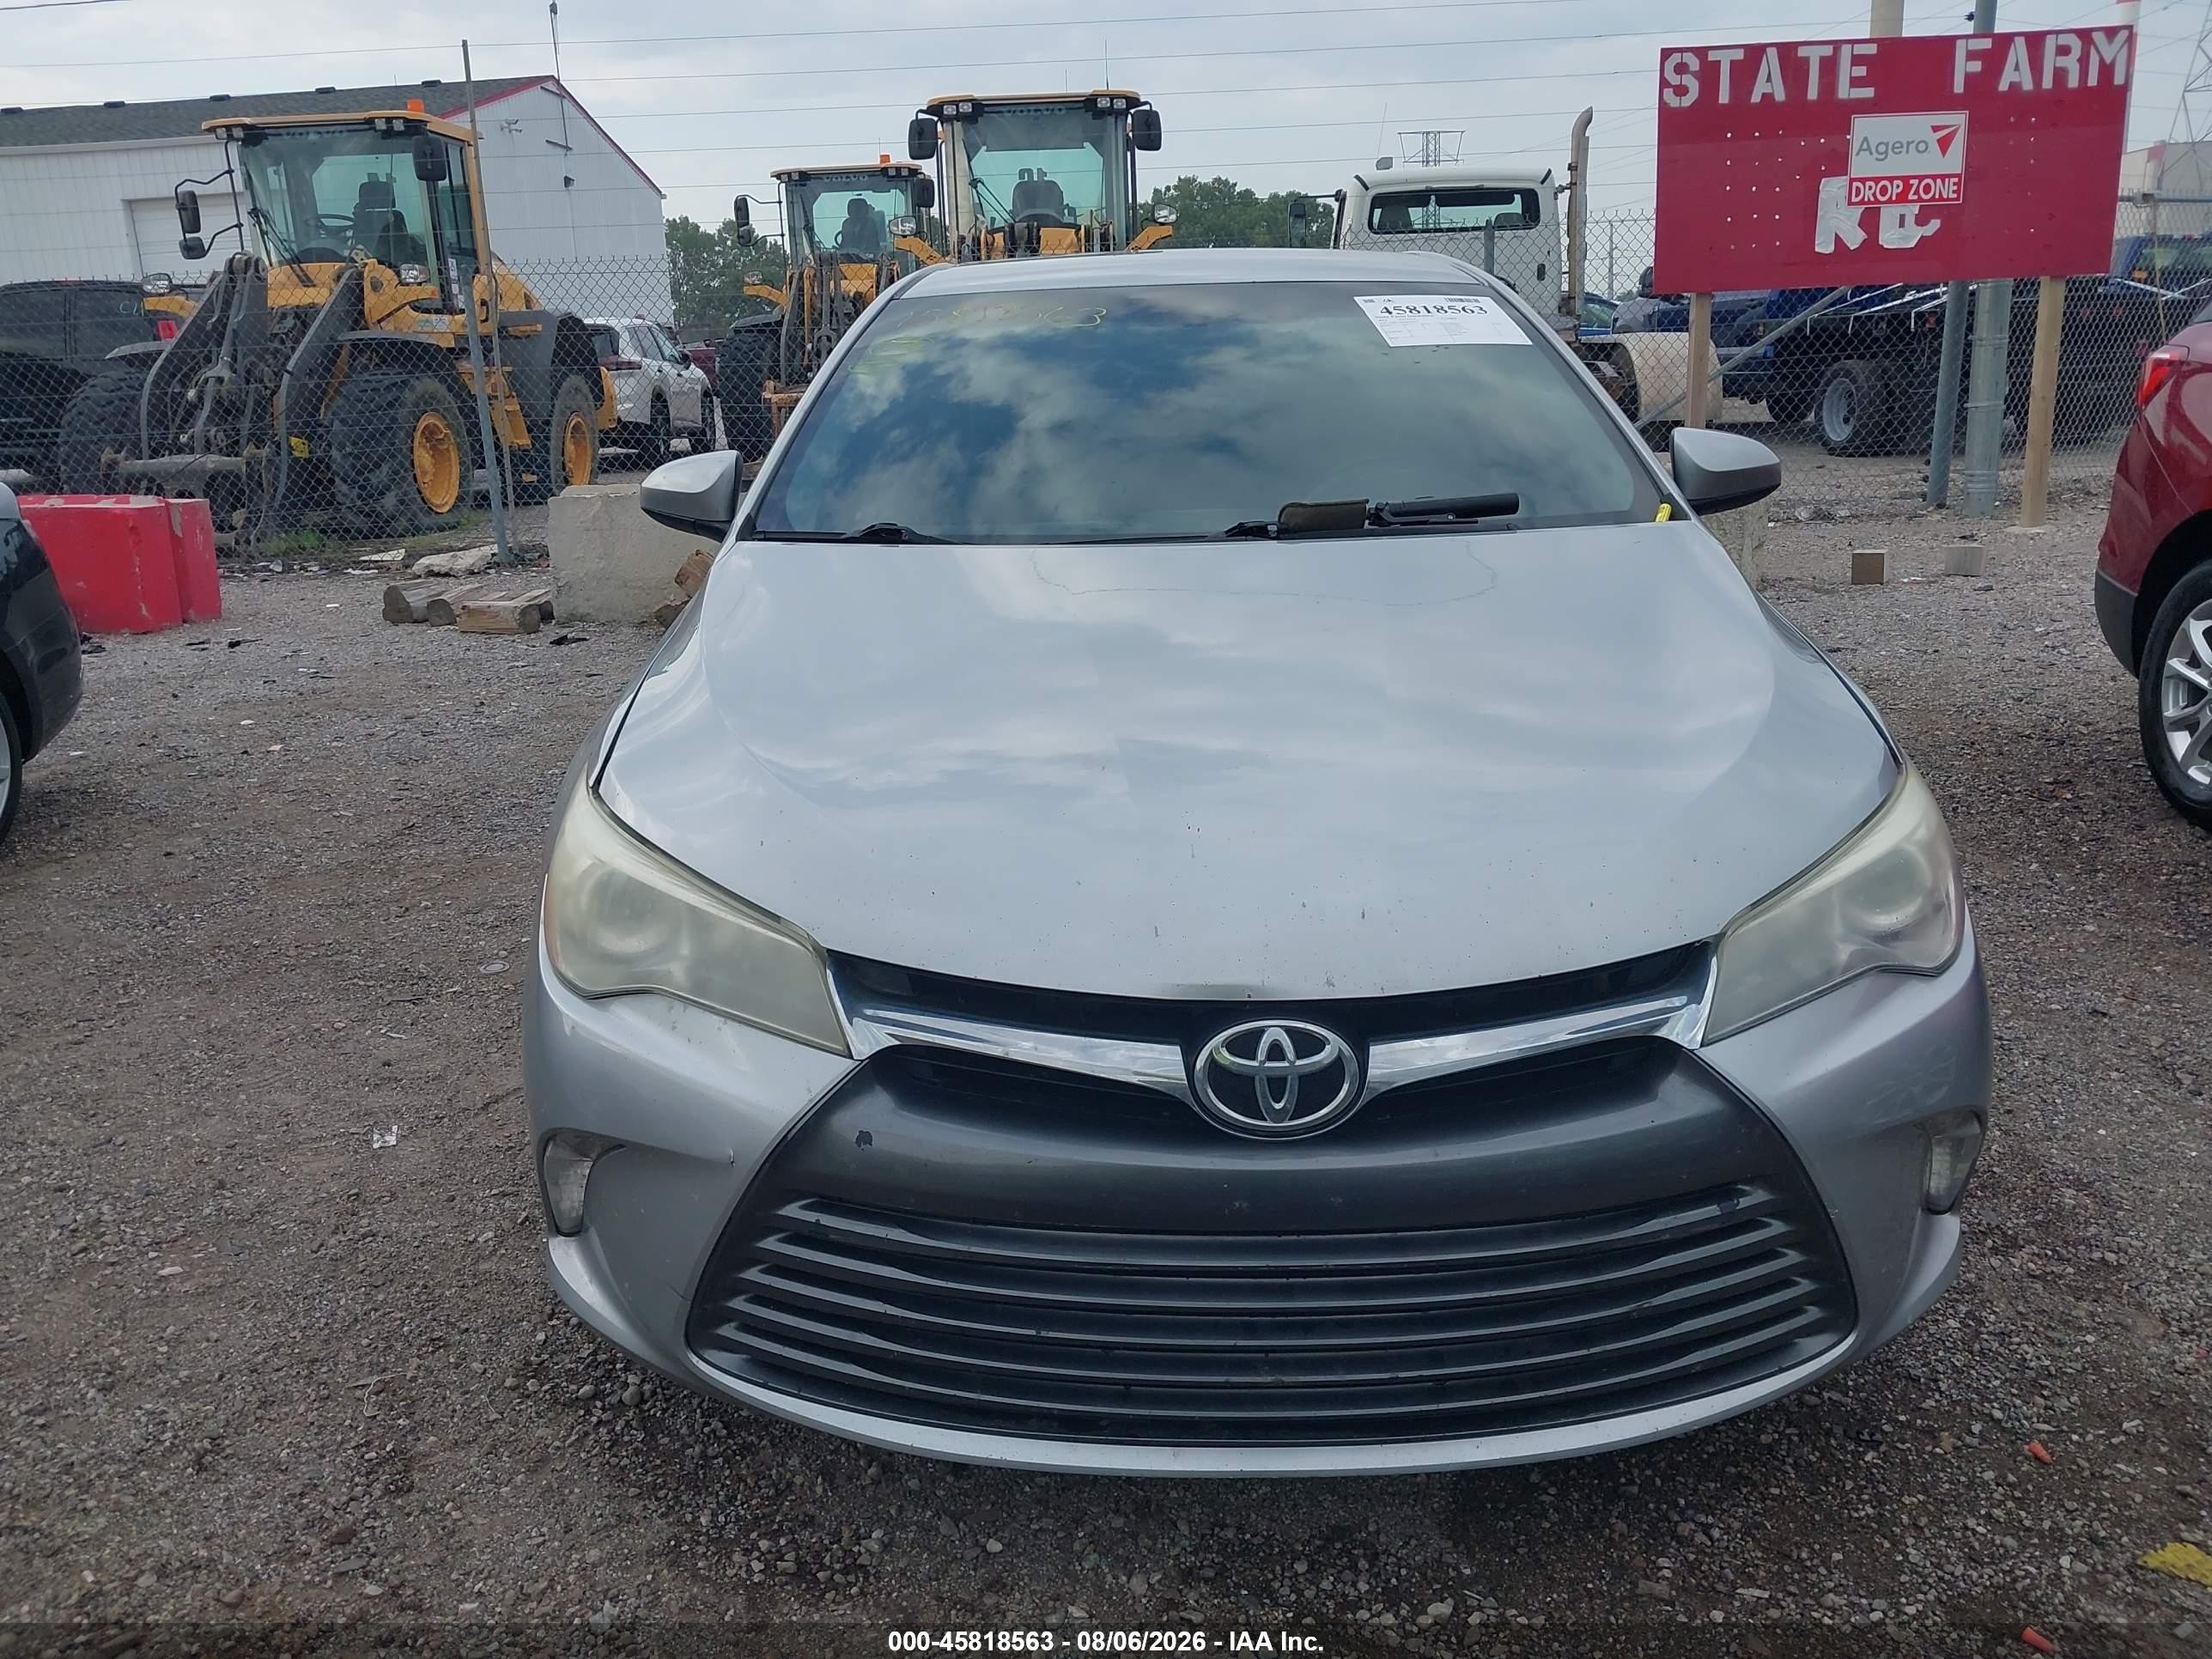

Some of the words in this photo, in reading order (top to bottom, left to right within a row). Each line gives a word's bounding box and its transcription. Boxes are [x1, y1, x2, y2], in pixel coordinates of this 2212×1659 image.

[1662, 43, 1877, 107] STATE
[1954, 29, 2130, 94] FARM
[1855, 135, 1929, 161] Agero
[1851, 180, 1903, 203] DROP
[1908, 177, 1959, 200] ZONE
[1380, 305, 1488, 315] 45818563
